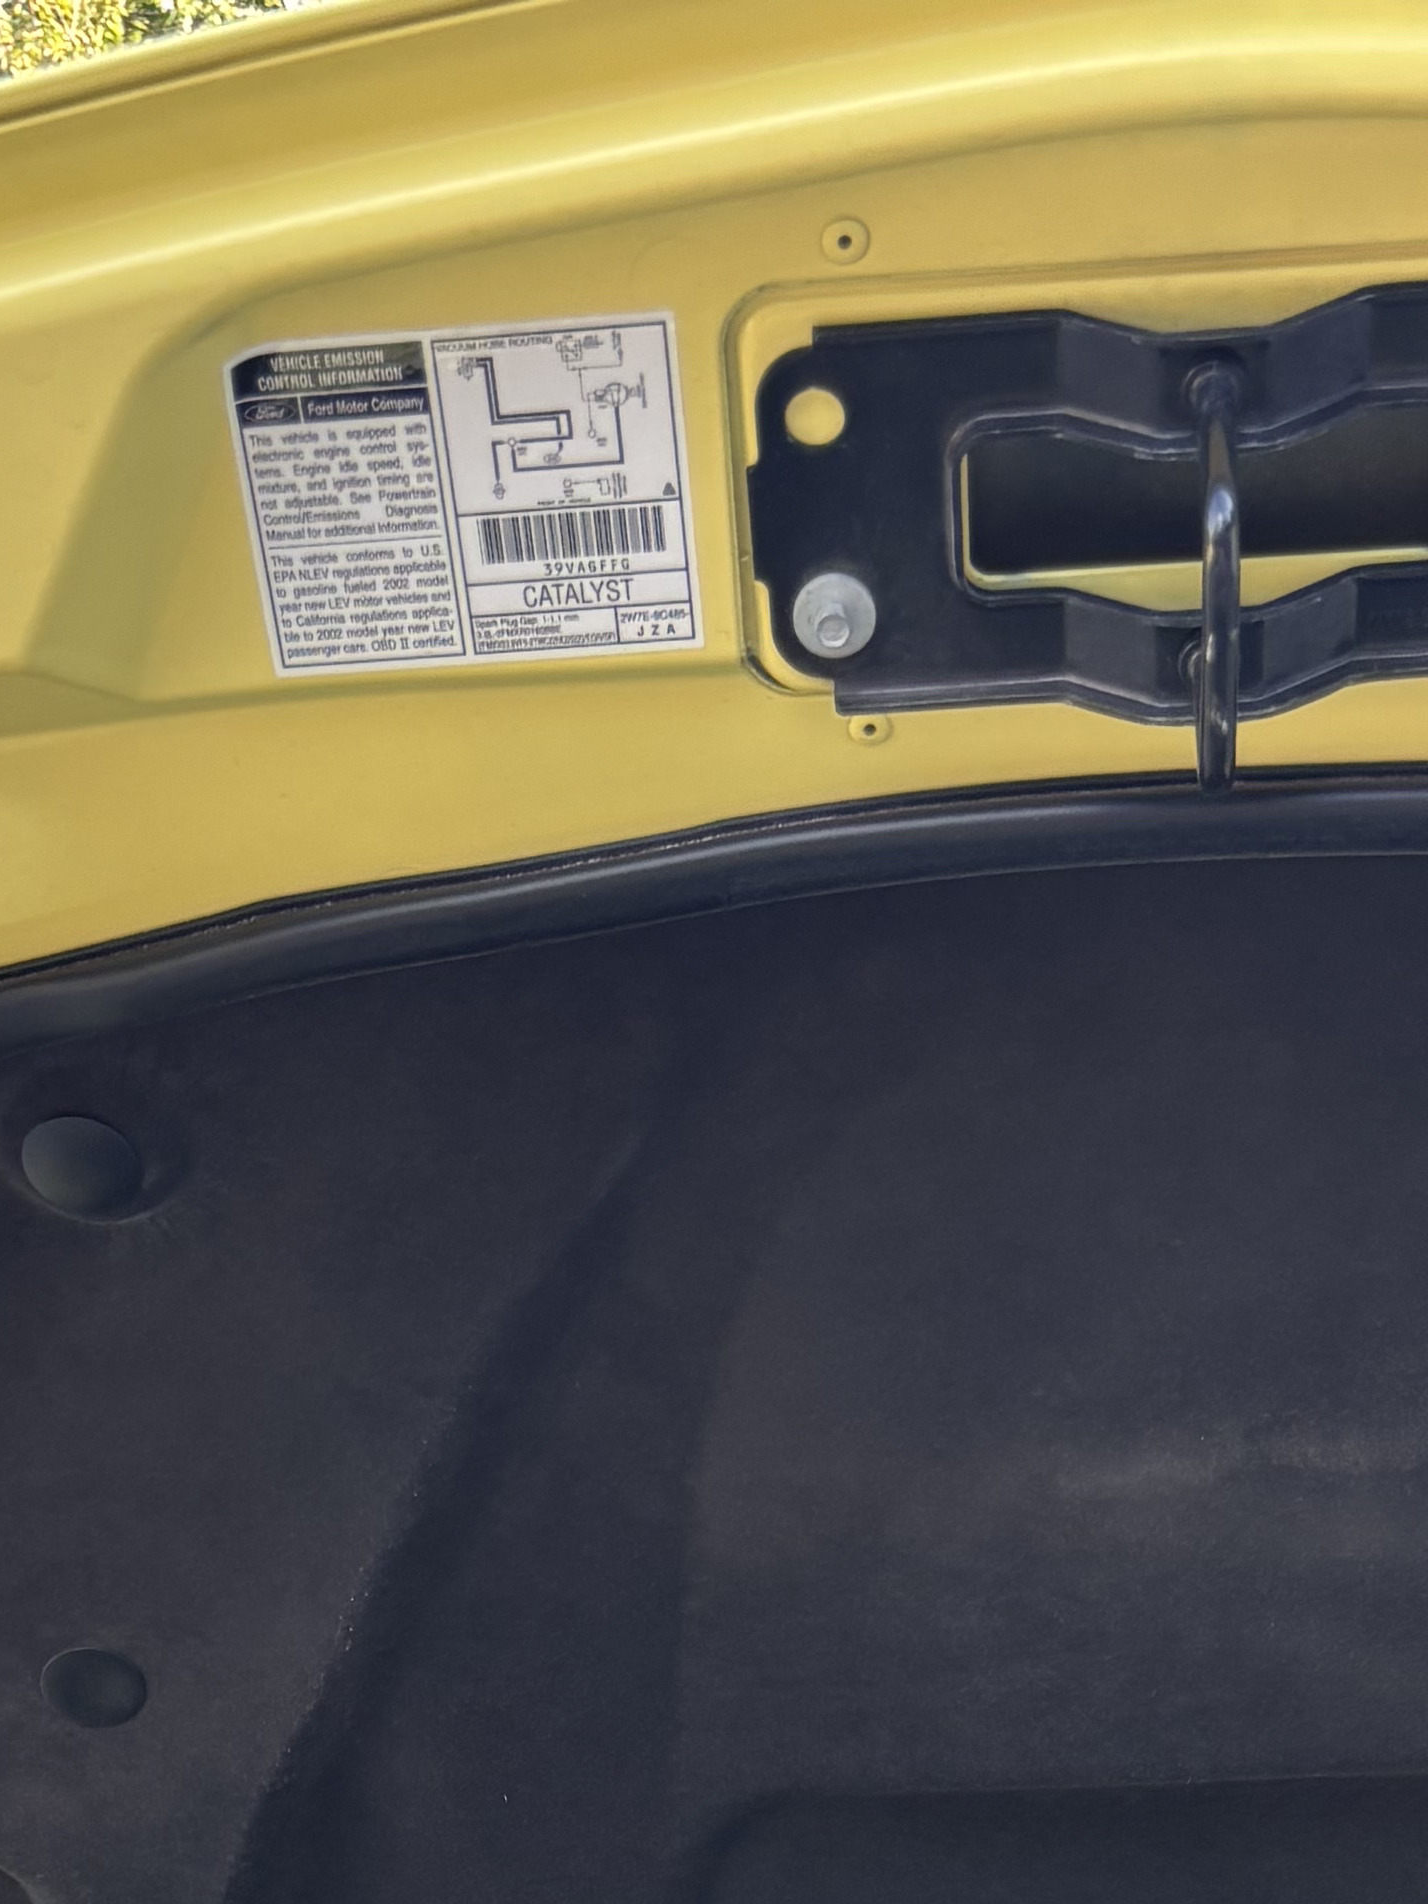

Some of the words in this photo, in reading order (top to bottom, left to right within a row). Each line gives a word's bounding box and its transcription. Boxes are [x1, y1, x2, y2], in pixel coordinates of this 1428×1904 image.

[269, 353, 321, 373] VEHICLE
[323, 348, 385, 368] EMISSION
[257, 372, 314, 392] CONTROL
[317, 364, 403, 388] INFORMATION
[307, 402, 333, 415] Ford
[334, 399, 367, 413] Motor
[370, 393, 424, 415] Company
[522, 577, 635, 608] CATALYST
